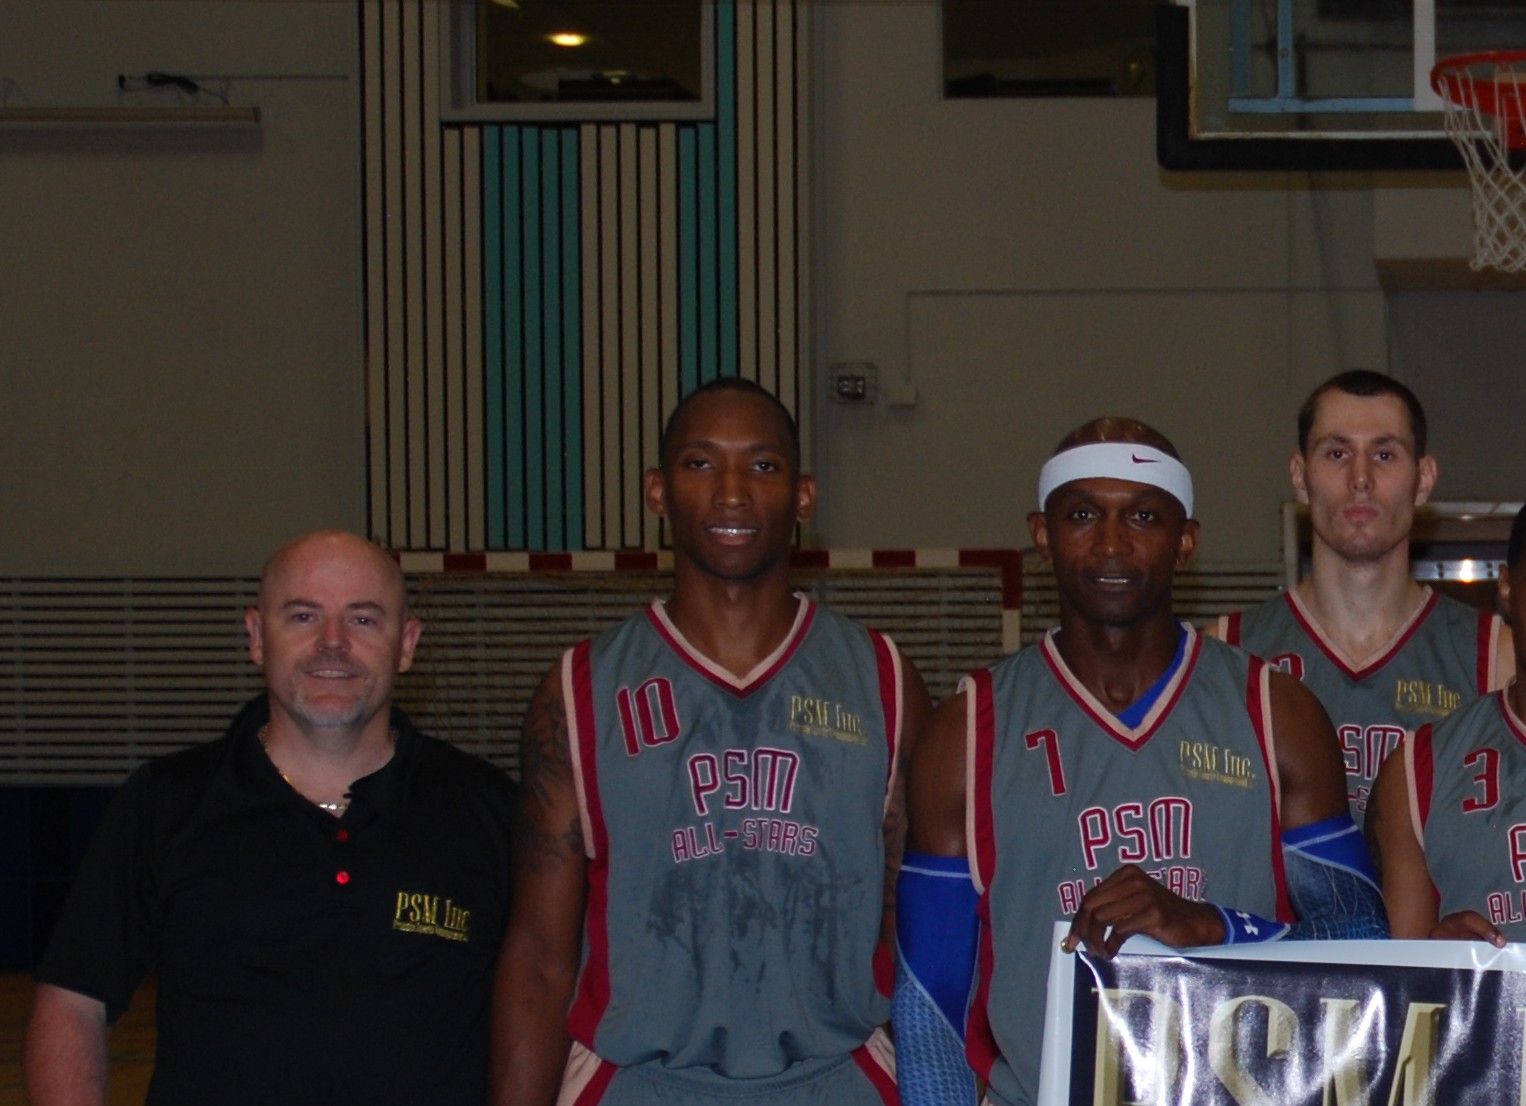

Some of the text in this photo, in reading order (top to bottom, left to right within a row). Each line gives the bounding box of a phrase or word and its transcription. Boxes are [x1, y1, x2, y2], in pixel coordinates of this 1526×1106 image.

[616, 677, 680, 756] 10
[790, 695, 830, 727] PSM
[1395, 680, 1432, 705] PSM
[1024, 729, 1066, 796] 7
[1180, 740, 1219, 771] PSM
[1337, 723, 1406, 780] SM
[687, 746, 801, 817] PSM
[1462, 747, 1500, 814] 3
[672, 817, 819, 864] ALL-STARS
[1078, 797, 1193, 870] PSM
[395, 891, 440, 924] PSM
